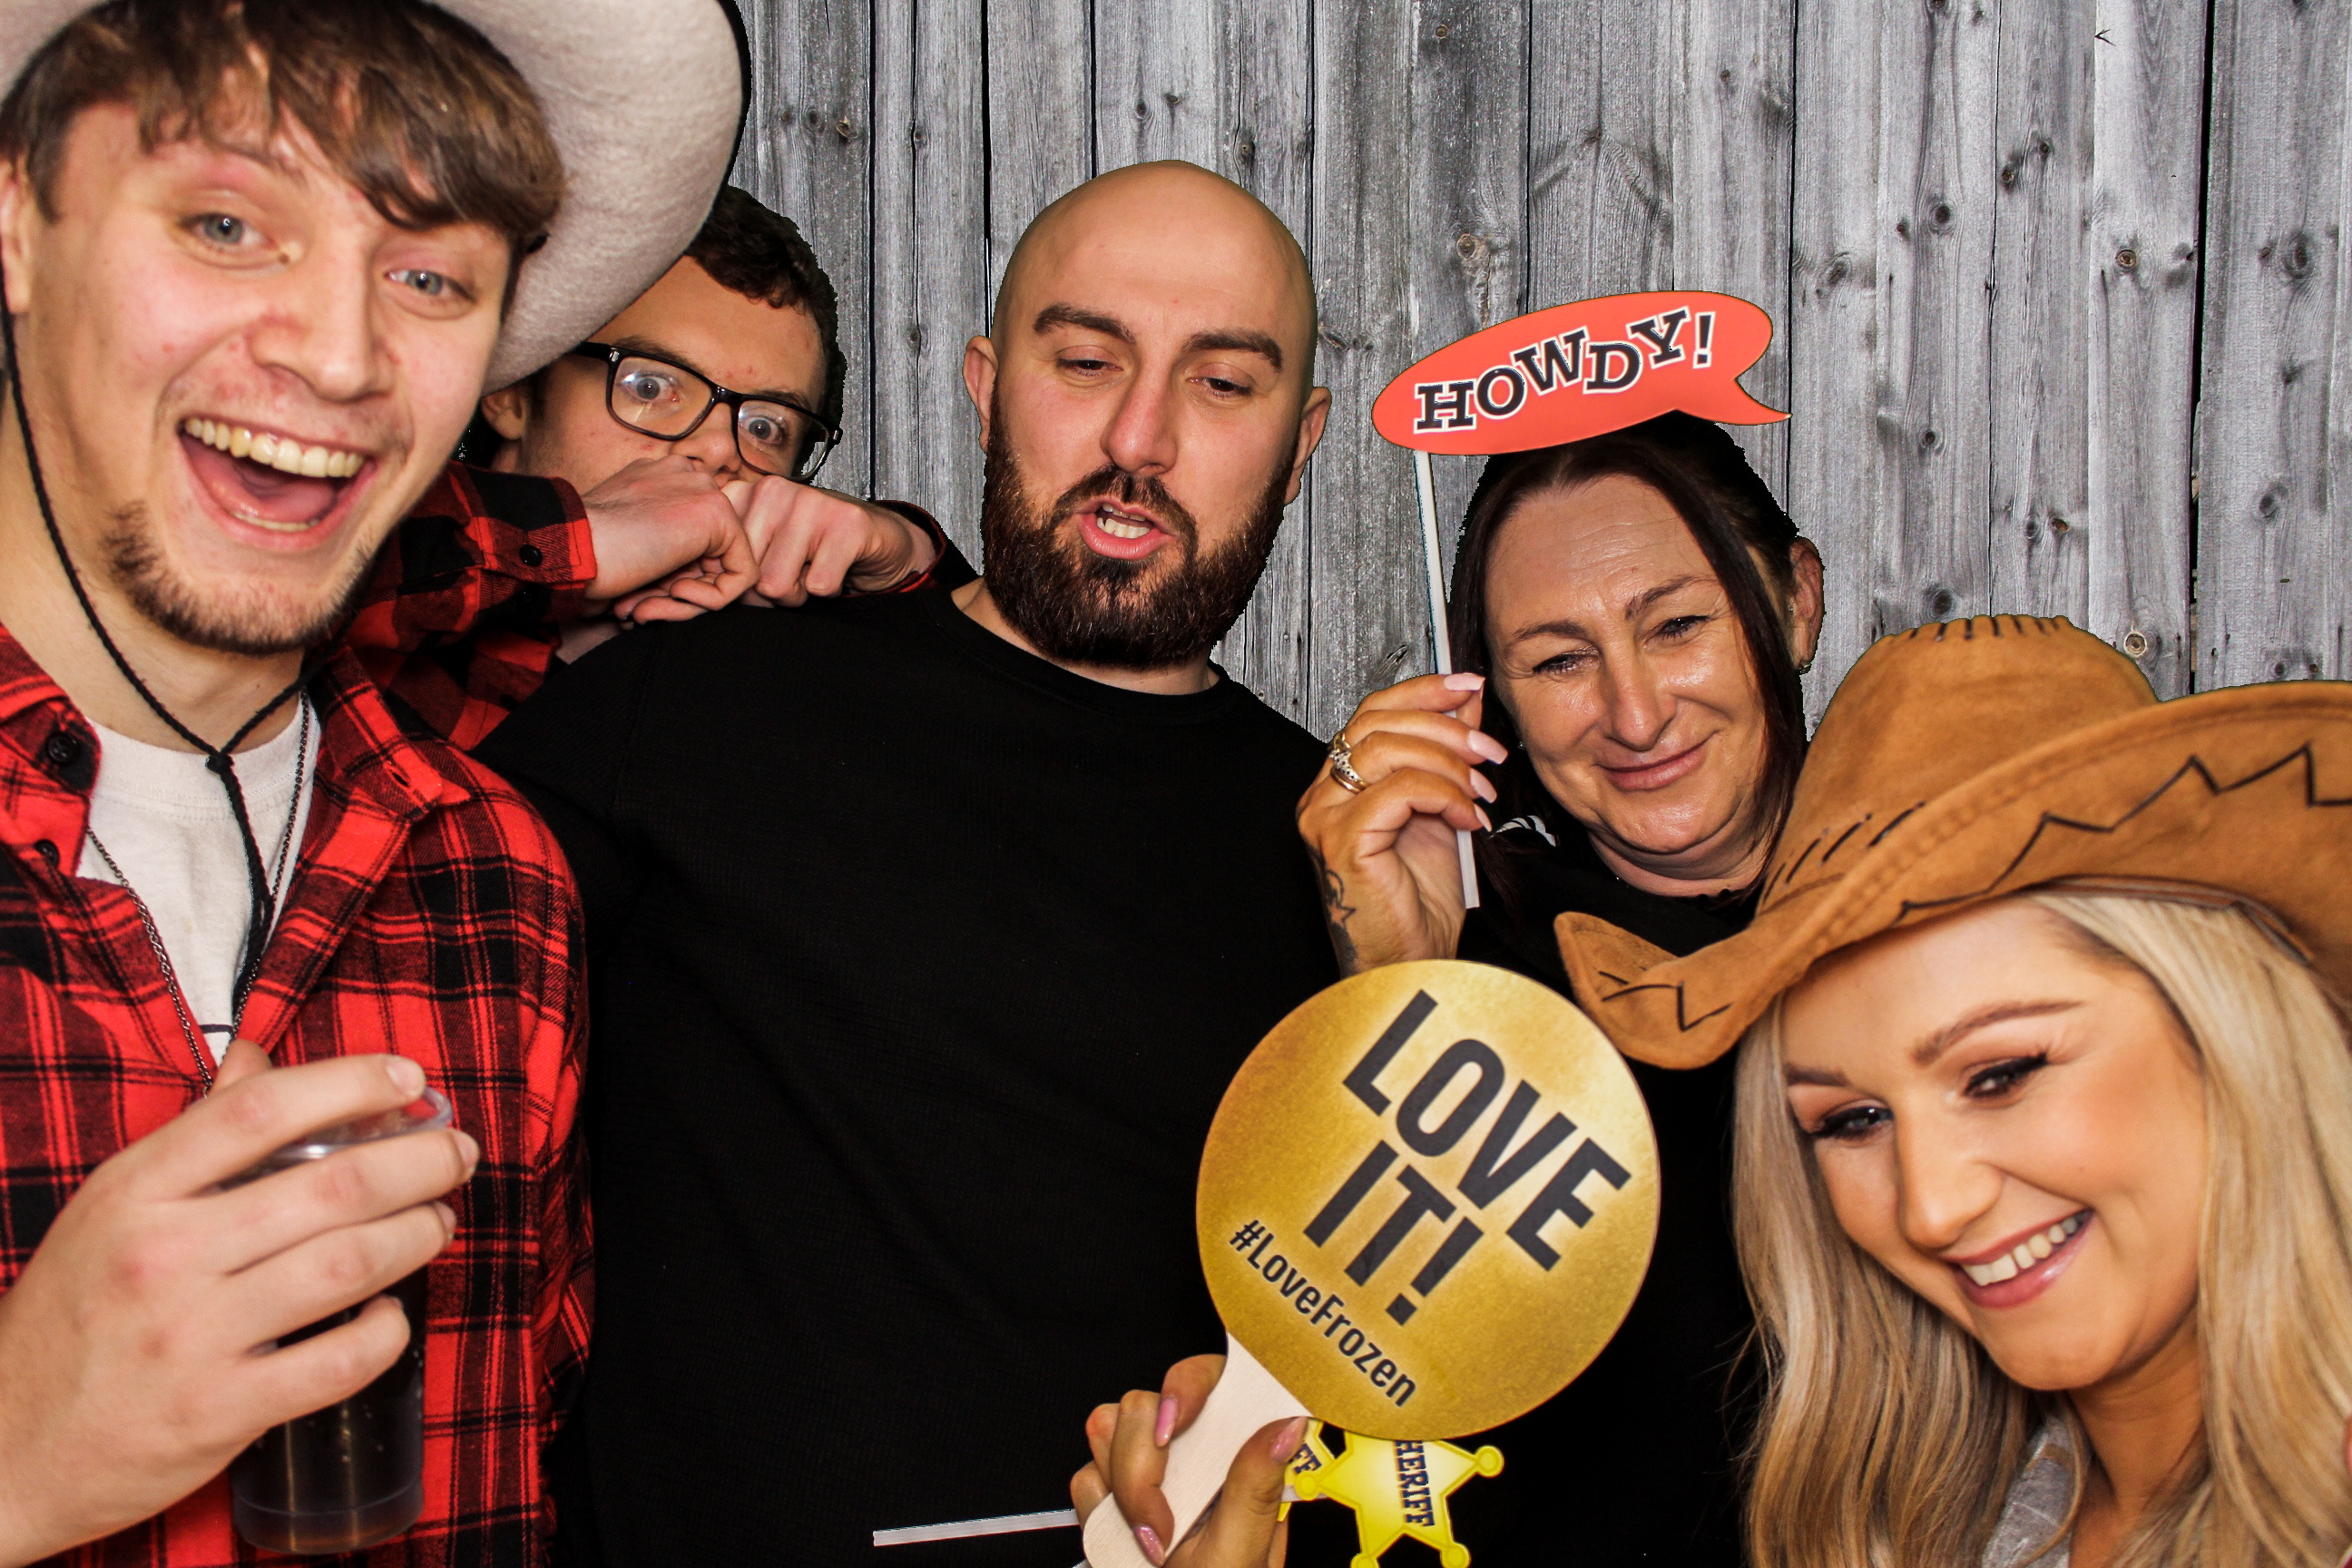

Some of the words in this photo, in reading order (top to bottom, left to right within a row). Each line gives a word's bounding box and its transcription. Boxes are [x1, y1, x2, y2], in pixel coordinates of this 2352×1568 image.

[1414, 306, 1716, 434] HOWDY!
[1342, 988, 1632, 1271] LOVE
[1229, 1220, 1417, 1407] #LoveFrozen
[1303, 1140, 1485, 1327] IT!
[1395, 1440, 1436, 1527] HERIFF
